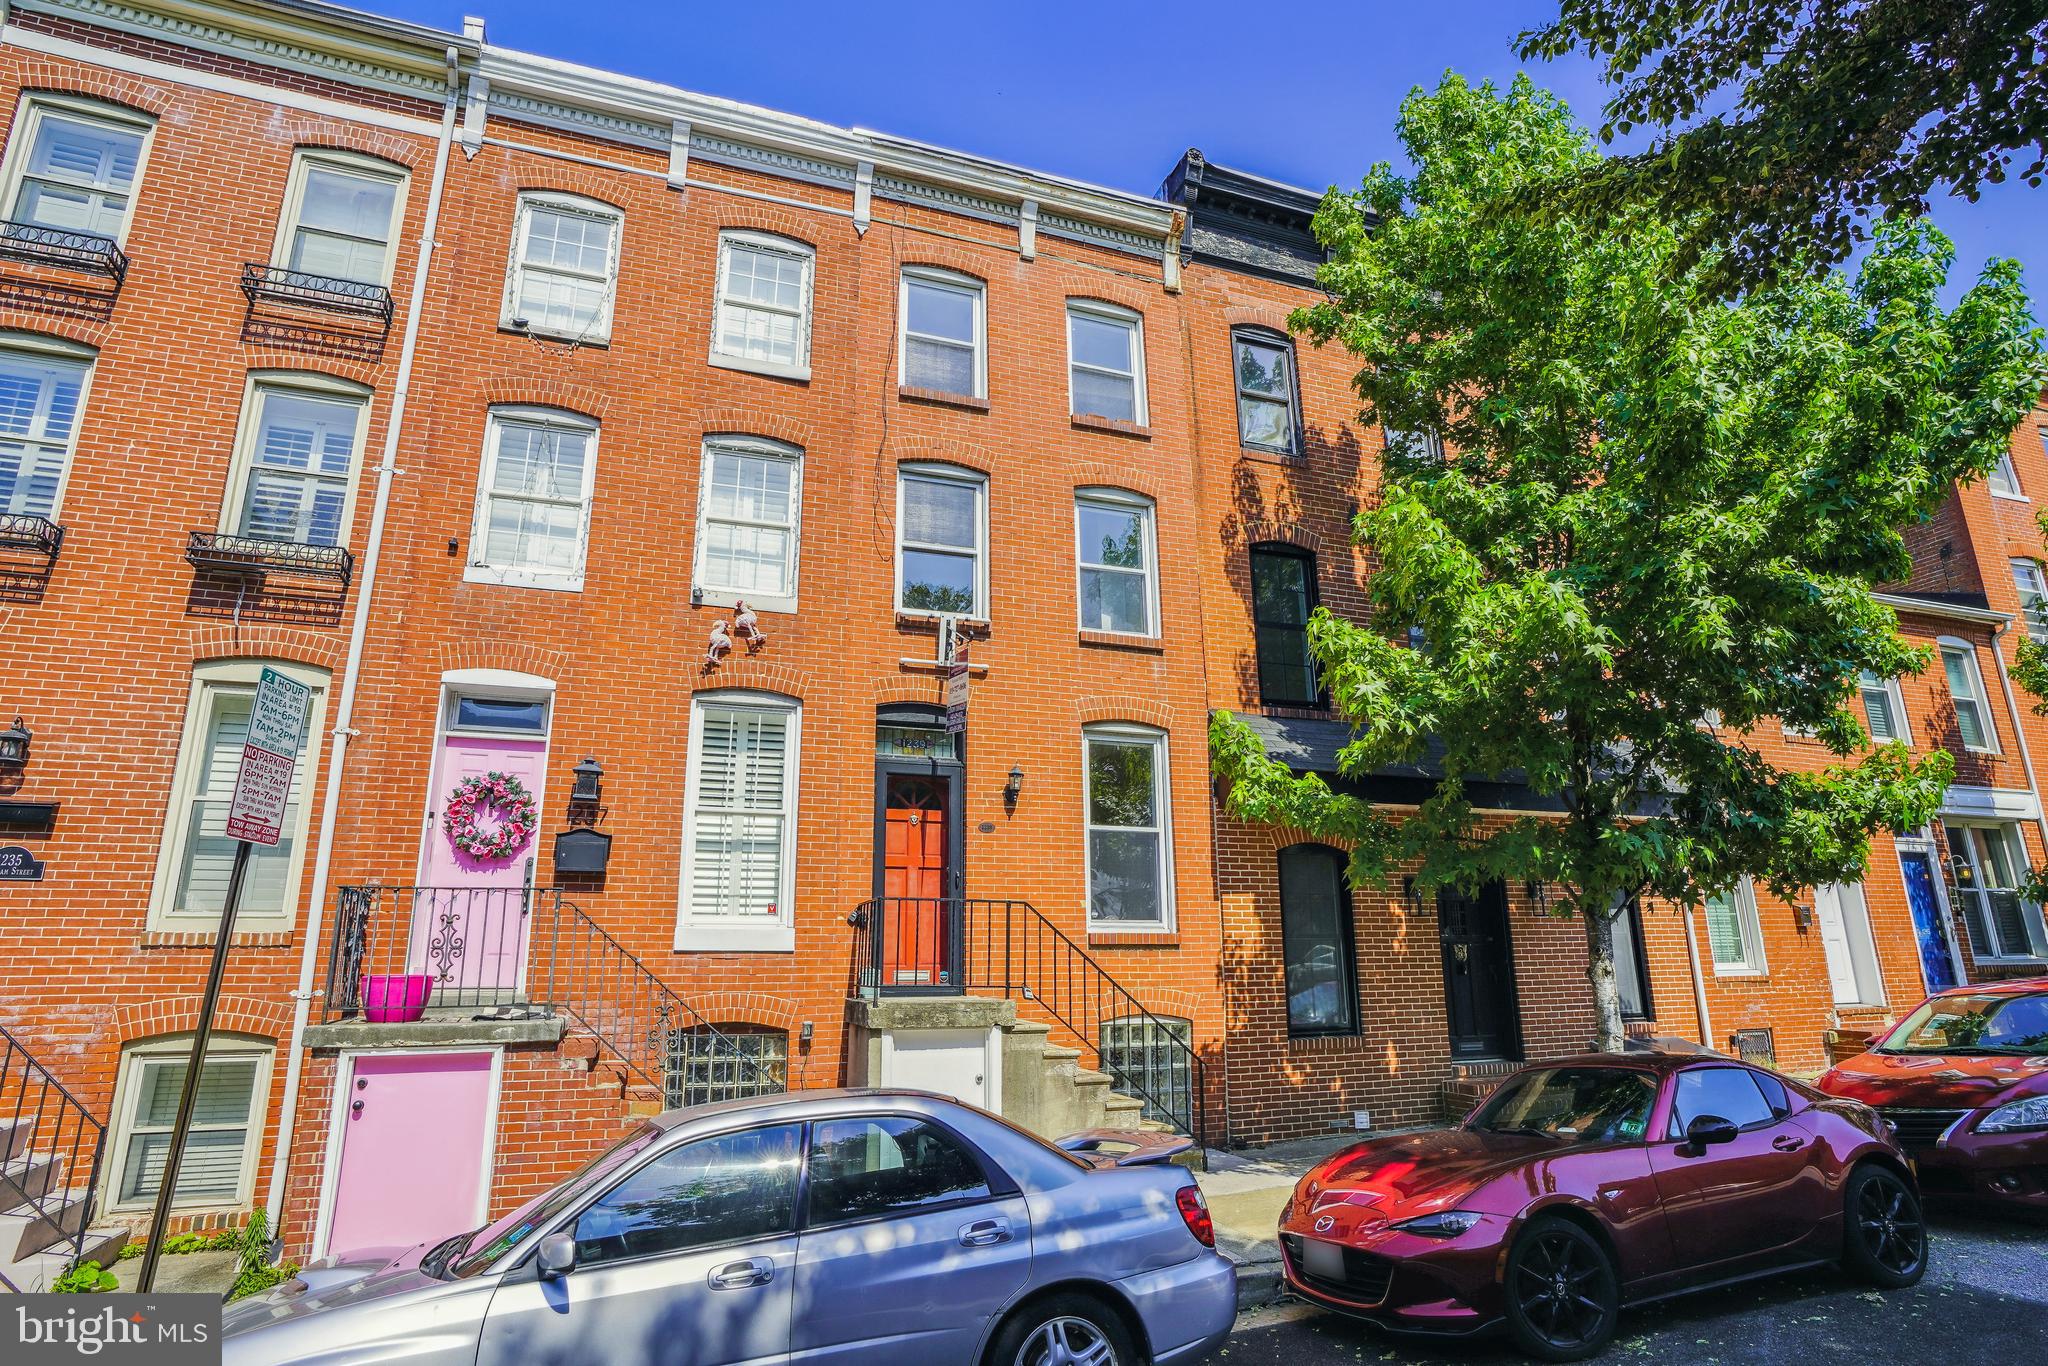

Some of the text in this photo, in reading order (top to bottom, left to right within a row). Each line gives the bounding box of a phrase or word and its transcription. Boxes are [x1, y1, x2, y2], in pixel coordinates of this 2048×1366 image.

[265, 671, 303, 697] 2 HOUR
[261, 692, 269, 701] IN
[269, 695, 287, 709] AREA
[263, 683, 302, 706] PARKING LIMIT
[258, 700, 299, 724] 7AM-6PM
[262, 713, 271, 721] MON
[272, 717, 284, 726] THRU
[254, 718, 296, 742] 7AM-2PM
[264, 733, 282, 744] SUNDAY
[244, 746, 291, 770] NO PARKING
[246, 759, 253, 768] IN
[254, 762, 273, 774] AREA
[243, 767, 286, 787] 6PM-7AM
[241, 784, 281, 803] 2PM-7AM
[229, 819, 278, 836] TOW AWAY ZONE
[261, 834, 277, 844] EVENTS
[0, 854, 22, 866] 235
